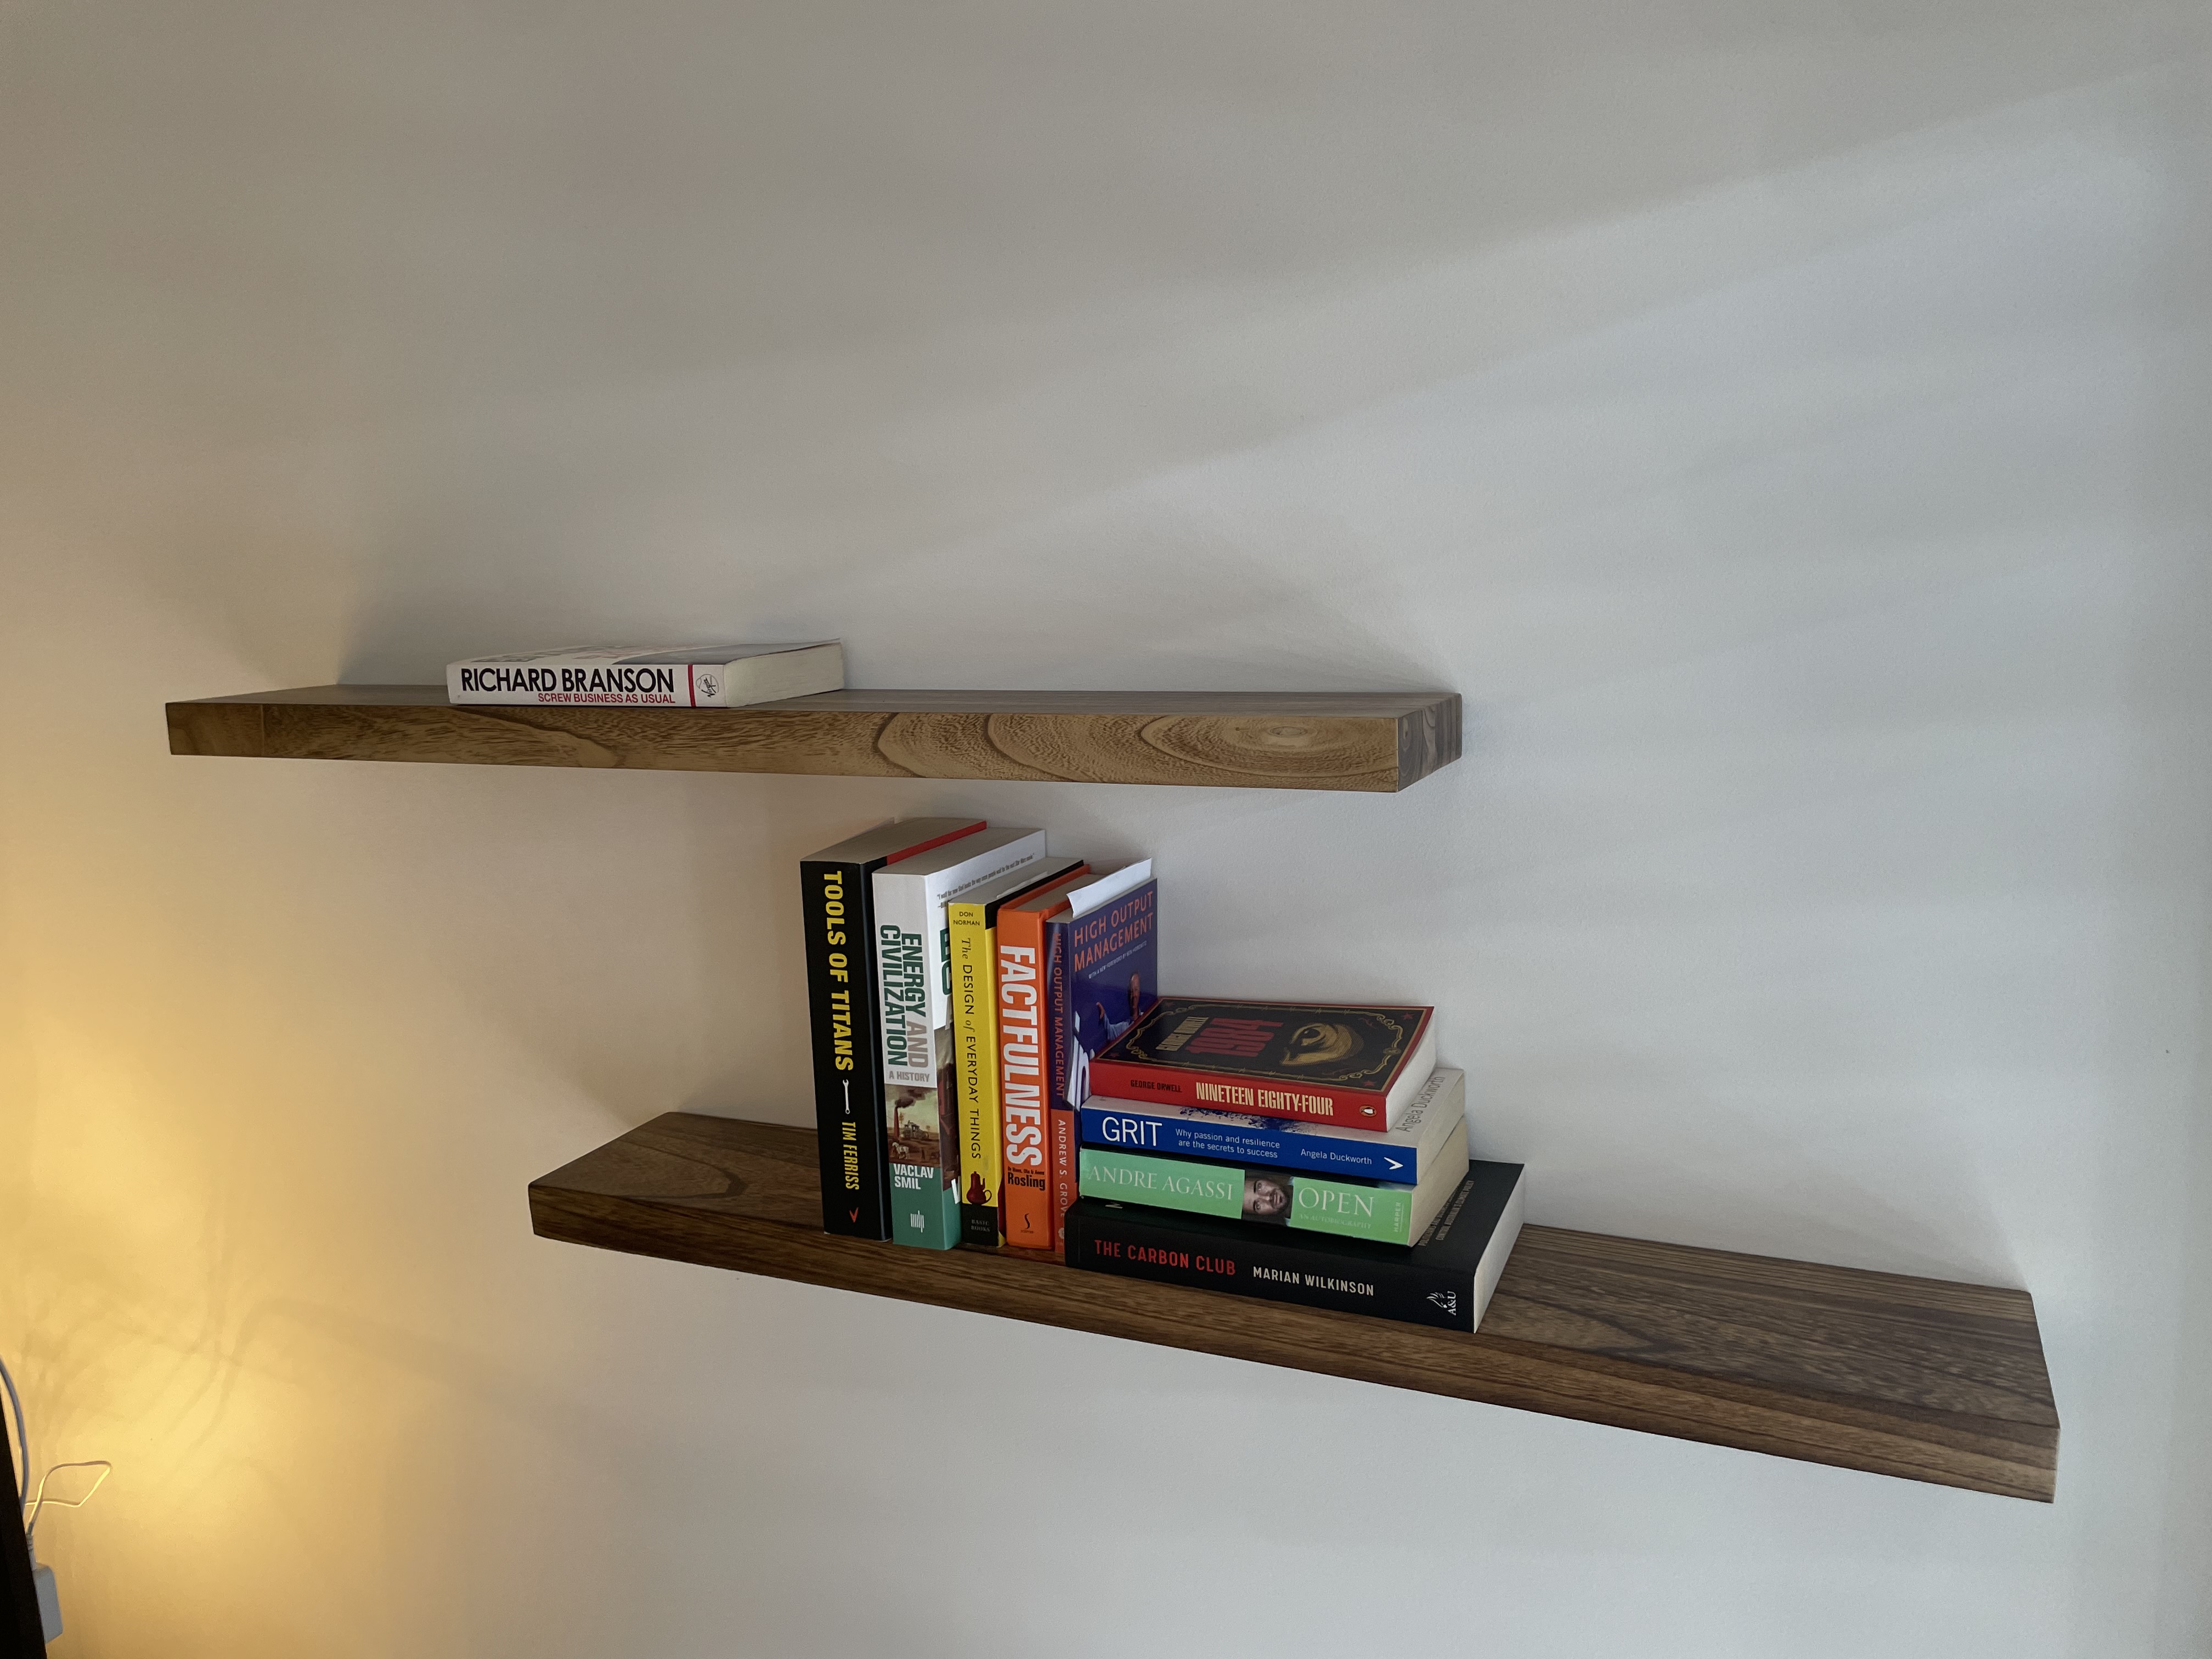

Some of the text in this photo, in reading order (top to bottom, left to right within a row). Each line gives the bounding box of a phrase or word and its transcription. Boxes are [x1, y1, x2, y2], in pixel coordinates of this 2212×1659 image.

[461, 668, 674, 692] RICHARD BRANSON
[538, 693, 675, 703] SCREW BUSINESS AS USUAL
[1074, 891, 1153, 947] HIGH OUTPUT
[1074, 912, 1153, 972] MANAGEMENT
[824, 871, 854, 1070] TOOLS OF TITANS
[880, 924, 908, 1066] CIVILIZATION
[901, 933, 928, 1068] ENERGY AND
[1053, 933, 1065, 1098] HIGH OUTPUT MANAGEMENT
[962, 938, 981, 1159] The DESIGN of EVERYDAY THINGS
[1185, 1018, 1284, 1057] 1984
[1000, 945, 1042, 1166] FACTFULNESS
[889, 1070, 929, 1082] A HISTORY
[1131, 1079, 1182, 1093] GEORGE ORWELL
[1196, 1082, 1334, 1116] NINETEEN EIGHTY-FOUR
[1395, 1076, 1446, 1132] Angela Duckworth
[1058, 1119, 1067, 1166] ANDREW
[1102, 1116, 1163, 1146] GRIT
[1176, 1128, 1192, 1139] Why
[1194, 1132, 1223, 1142] passion
[1242, 1138, 1280, 1149] resilience
[842, 1122, 859, 1190] TIM FERRISS
[1193, 1140, 1205, 1148] the
[1207, 1143, 1234, 1153] secrets
[1237, 1146, 1245, 1154] to
[1246, 1149, 1278, 1158] success
[1300, 1149, 1372, 1165] Angela Duckworth
[893, 1163, 934, 1178] VACLAV
[894, 1176, 921, 1190] SMIL
[1008, 1172, 1045, 1191] Rosling
[1088, 1165, 1233, 1200] ANDRE AGASSI
[1299, 1187, 1374, 1217] OPEN
[1094, 1239, 1235, 1276] THE CARBON CLUB
[1253, 1266, 1374, 1296] MARIAN WILKINSON
[1447, 1290, 1457, 1316] A&U
